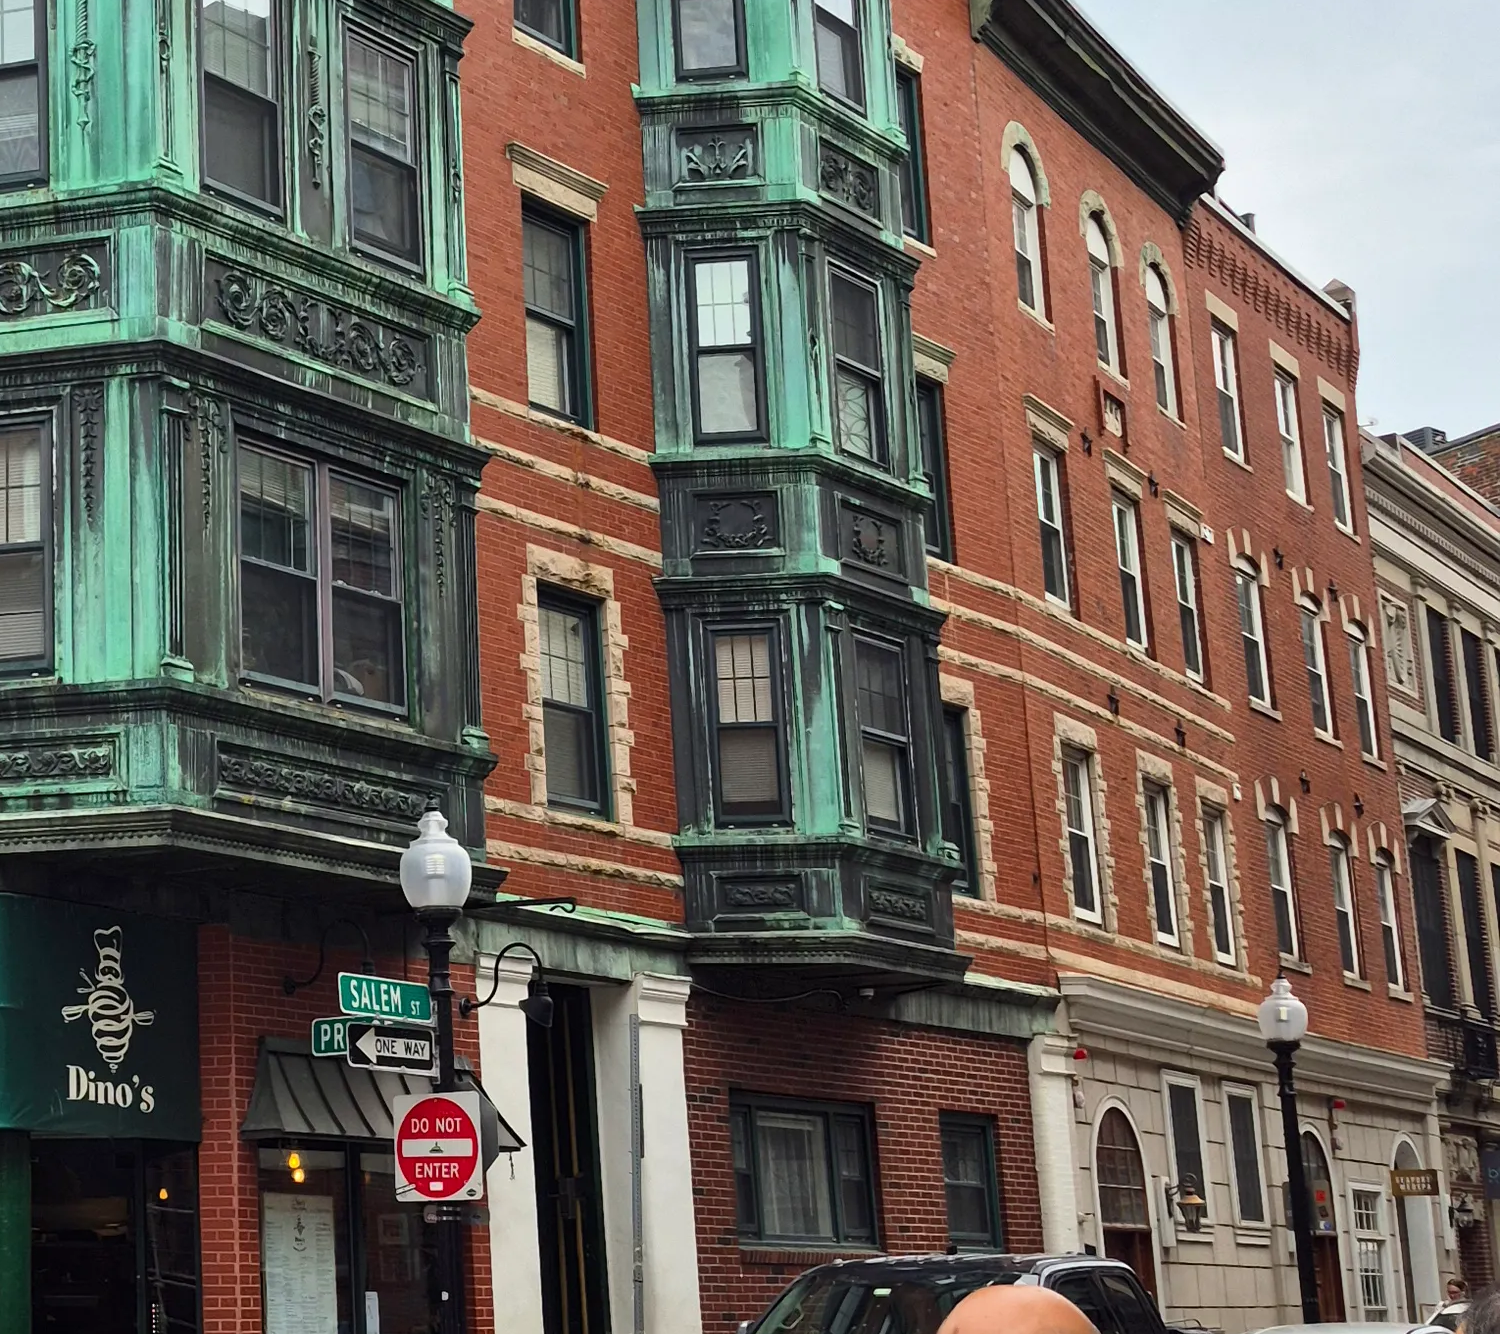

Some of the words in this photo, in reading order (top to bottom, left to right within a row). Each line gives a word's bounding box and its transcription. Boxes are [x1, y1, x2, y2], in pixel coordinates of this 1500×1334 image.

[350, 979, 402, 1013] SALEM
[411, 1000, 420, 1015] ST
[375, 1038, 398, 1055] ONE
[404, 1041, 426, 1057] WAY
[66, 1064, 155, 1114] Dino's
[411, 1118, 429, 1133] DO
[435, 1117, 462, 1133] NOT
[415, 1162, 460, 1178] ENTER
